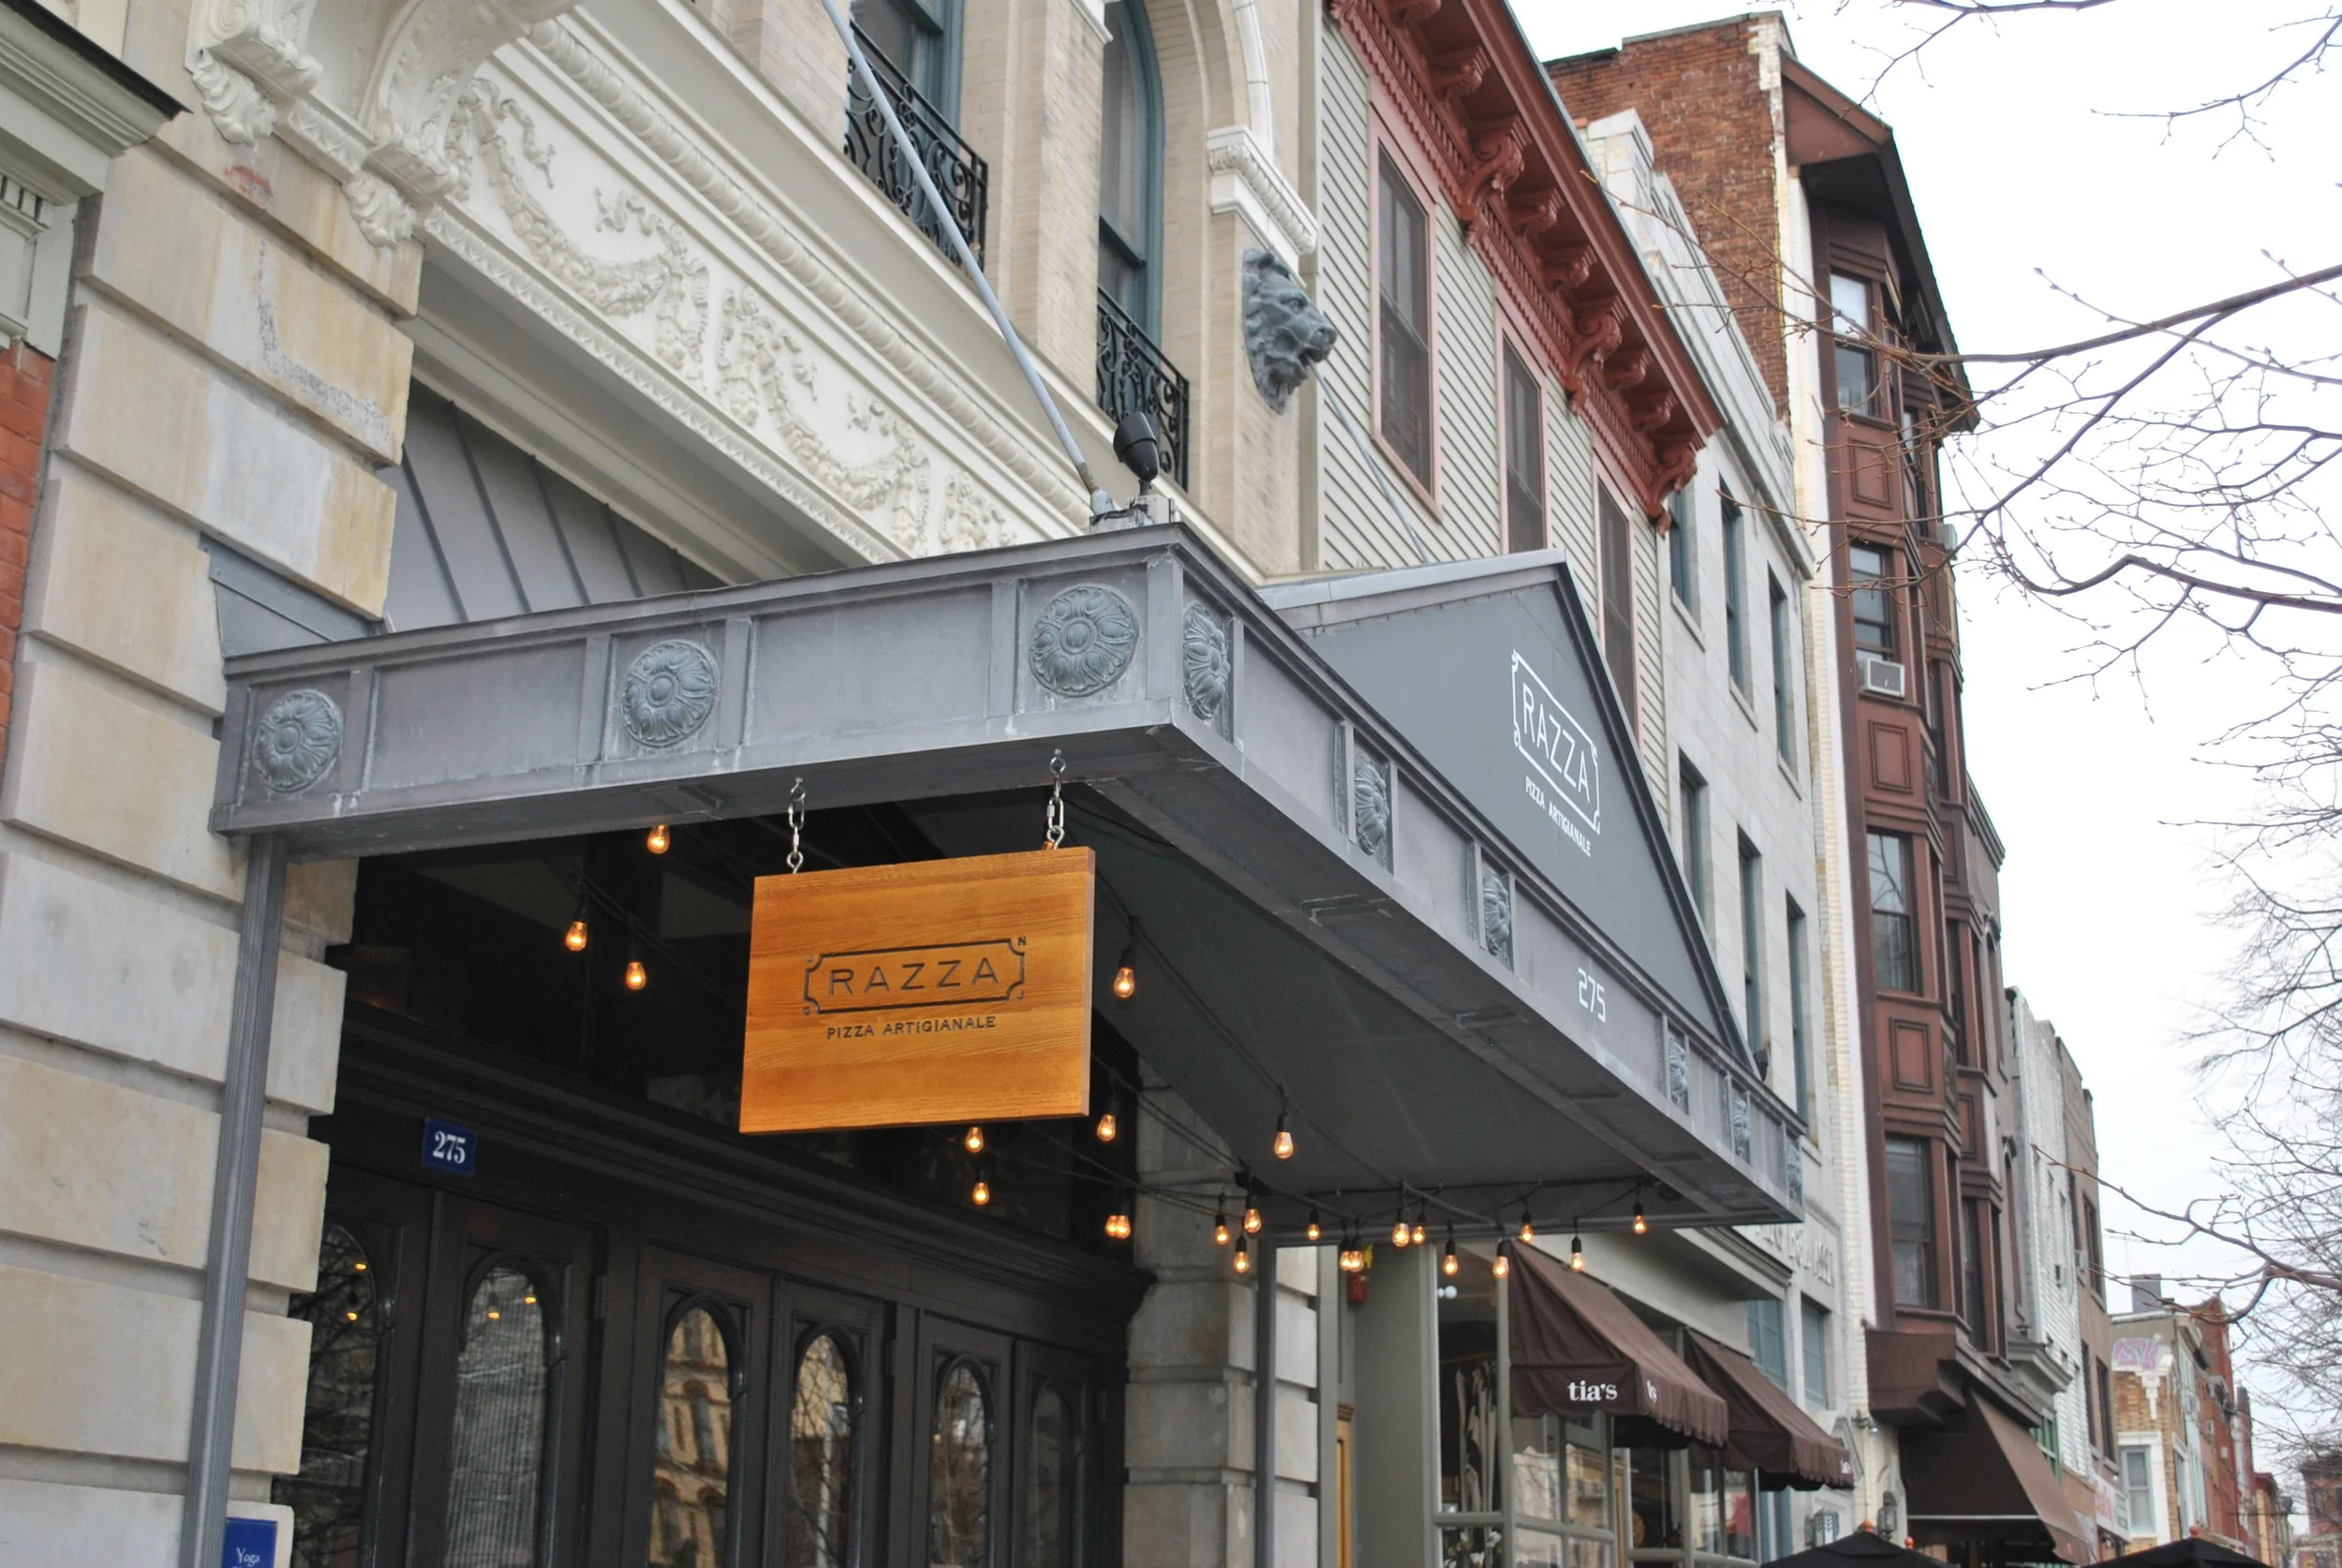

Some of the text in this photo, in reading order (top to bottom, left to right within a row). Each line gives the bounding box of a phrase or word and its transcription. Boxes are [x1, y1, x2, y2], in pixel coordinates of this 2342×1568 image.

[1522, 682, 1591, 803] RAZZA
[1525, 776, 1592, 858] PIZZA ARTIGIANALE
[1017, 937, 1027, 946] N
[829, 957, 999, 996] RAZZA
[1578, 967, 1606, 1023] 275
[826, 1015, 997, 1040] PIZZA ARTIGIANALE
[433, 1131, 467, 1163] 275
[1567, 1380, 1618, 1401] tia's
[236, 1546, 260, 1567] Yoga
